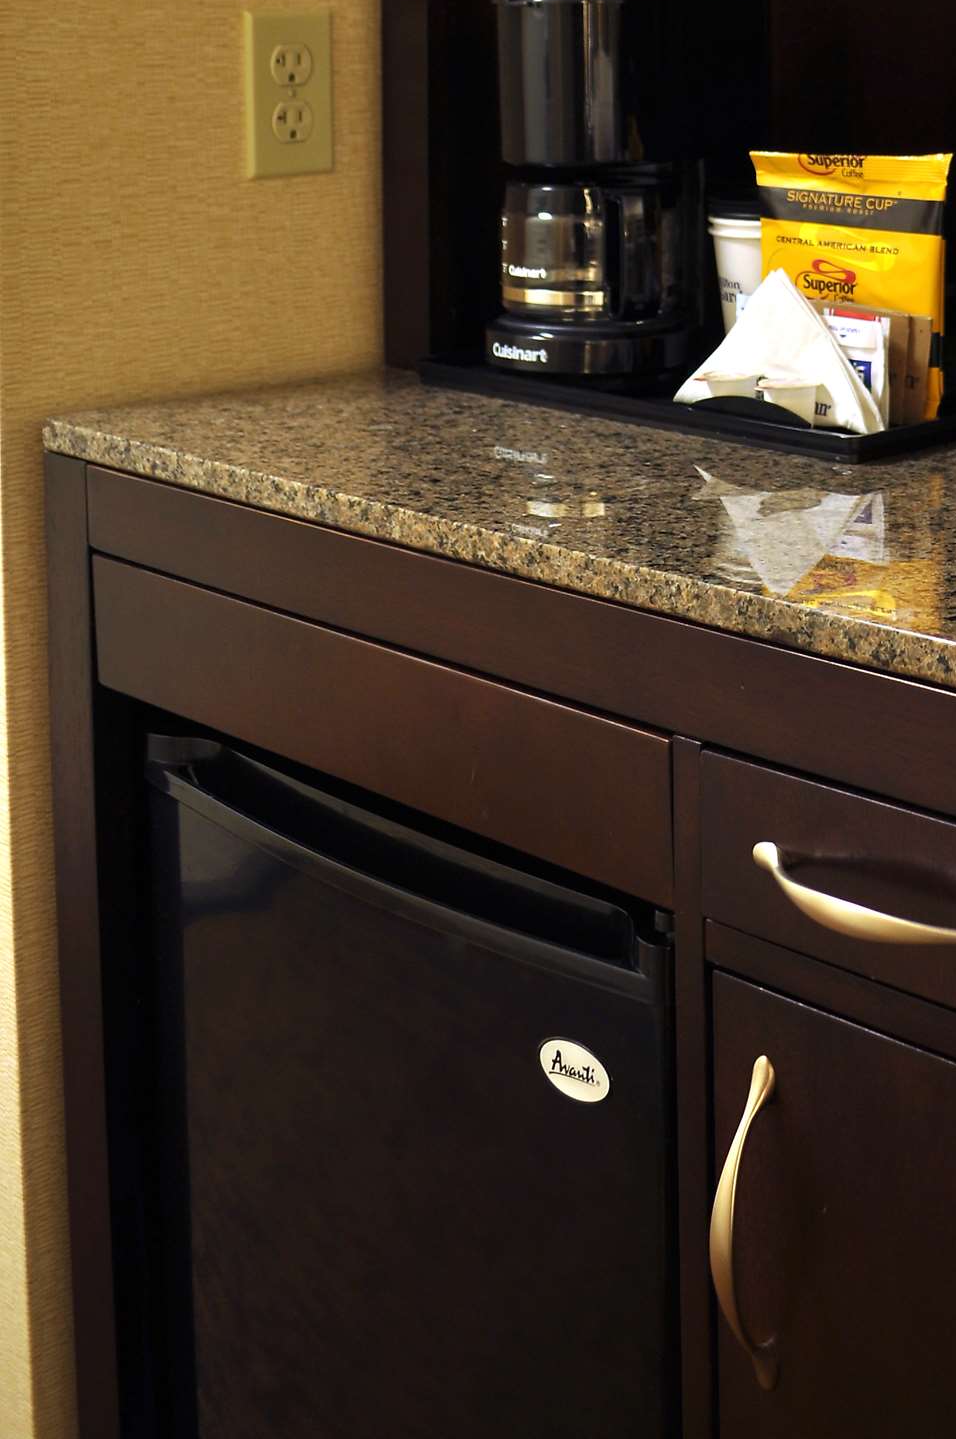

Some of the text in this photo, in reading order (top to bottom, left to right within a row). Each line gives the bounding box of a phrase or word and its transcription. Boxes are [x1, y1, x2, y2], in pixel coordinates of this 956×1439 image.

[807, 154, 865, 169] Superior
[786, 190, 894, 211] SIGNATURE CUP
[776, 235, 900, 256] CENTRAL AMERICAN BLEND
[508, 265, 547, 279] Cuisinart
[803, 274, 857, 296] Superior
[492, 342, 548, 363] Cuisinart
[550, 1050, 596, 1084] Avanti
